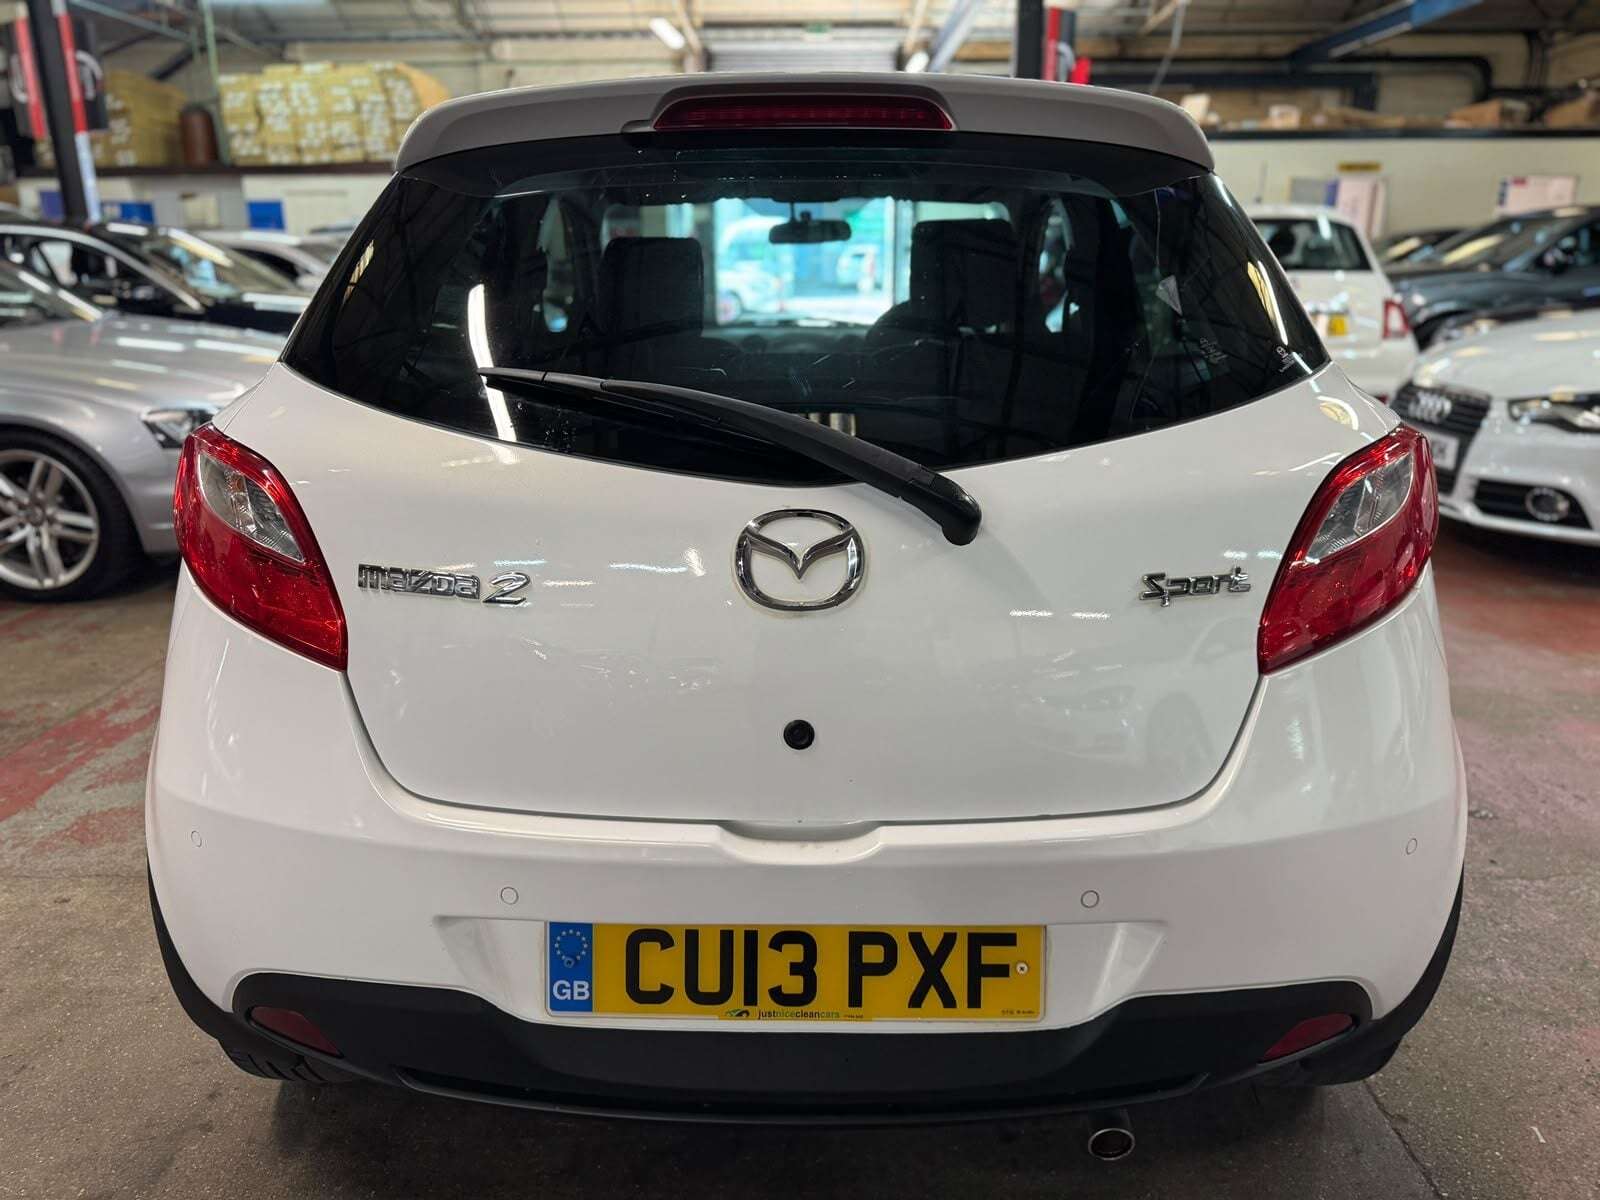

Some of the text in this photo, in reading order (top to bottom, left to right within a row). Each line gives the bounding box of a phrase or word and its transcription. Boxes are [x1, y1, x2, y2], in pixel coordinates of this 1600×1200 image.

[482, 571, 531, 604] 2
[1139, 566, 1252, 607] Sport
[625, 928, 1018, 1009] CU13 PXF
[552, 980, 590, 1001] GB
